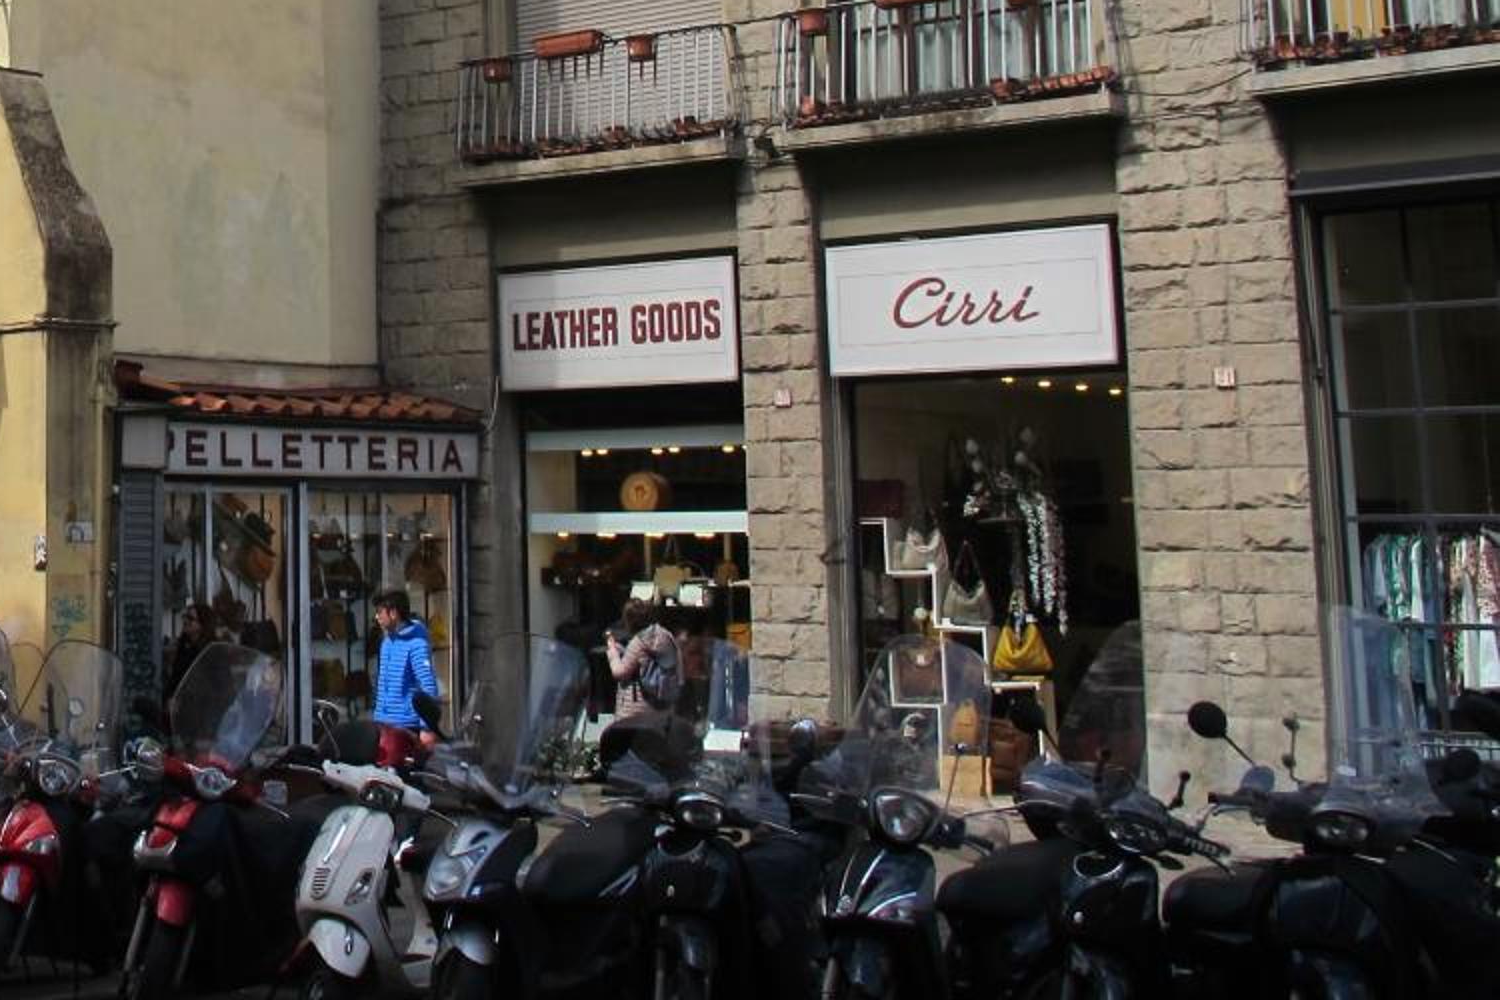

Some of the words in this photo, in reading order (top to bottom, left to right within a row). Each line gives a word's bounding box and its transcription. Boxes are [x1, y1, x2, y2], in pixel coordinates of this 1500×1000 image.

[512, 306, 619, 351] LEATHER
[630, 299, 722, 344] GOODS
[893, 276, 1040, 329] Cirri
